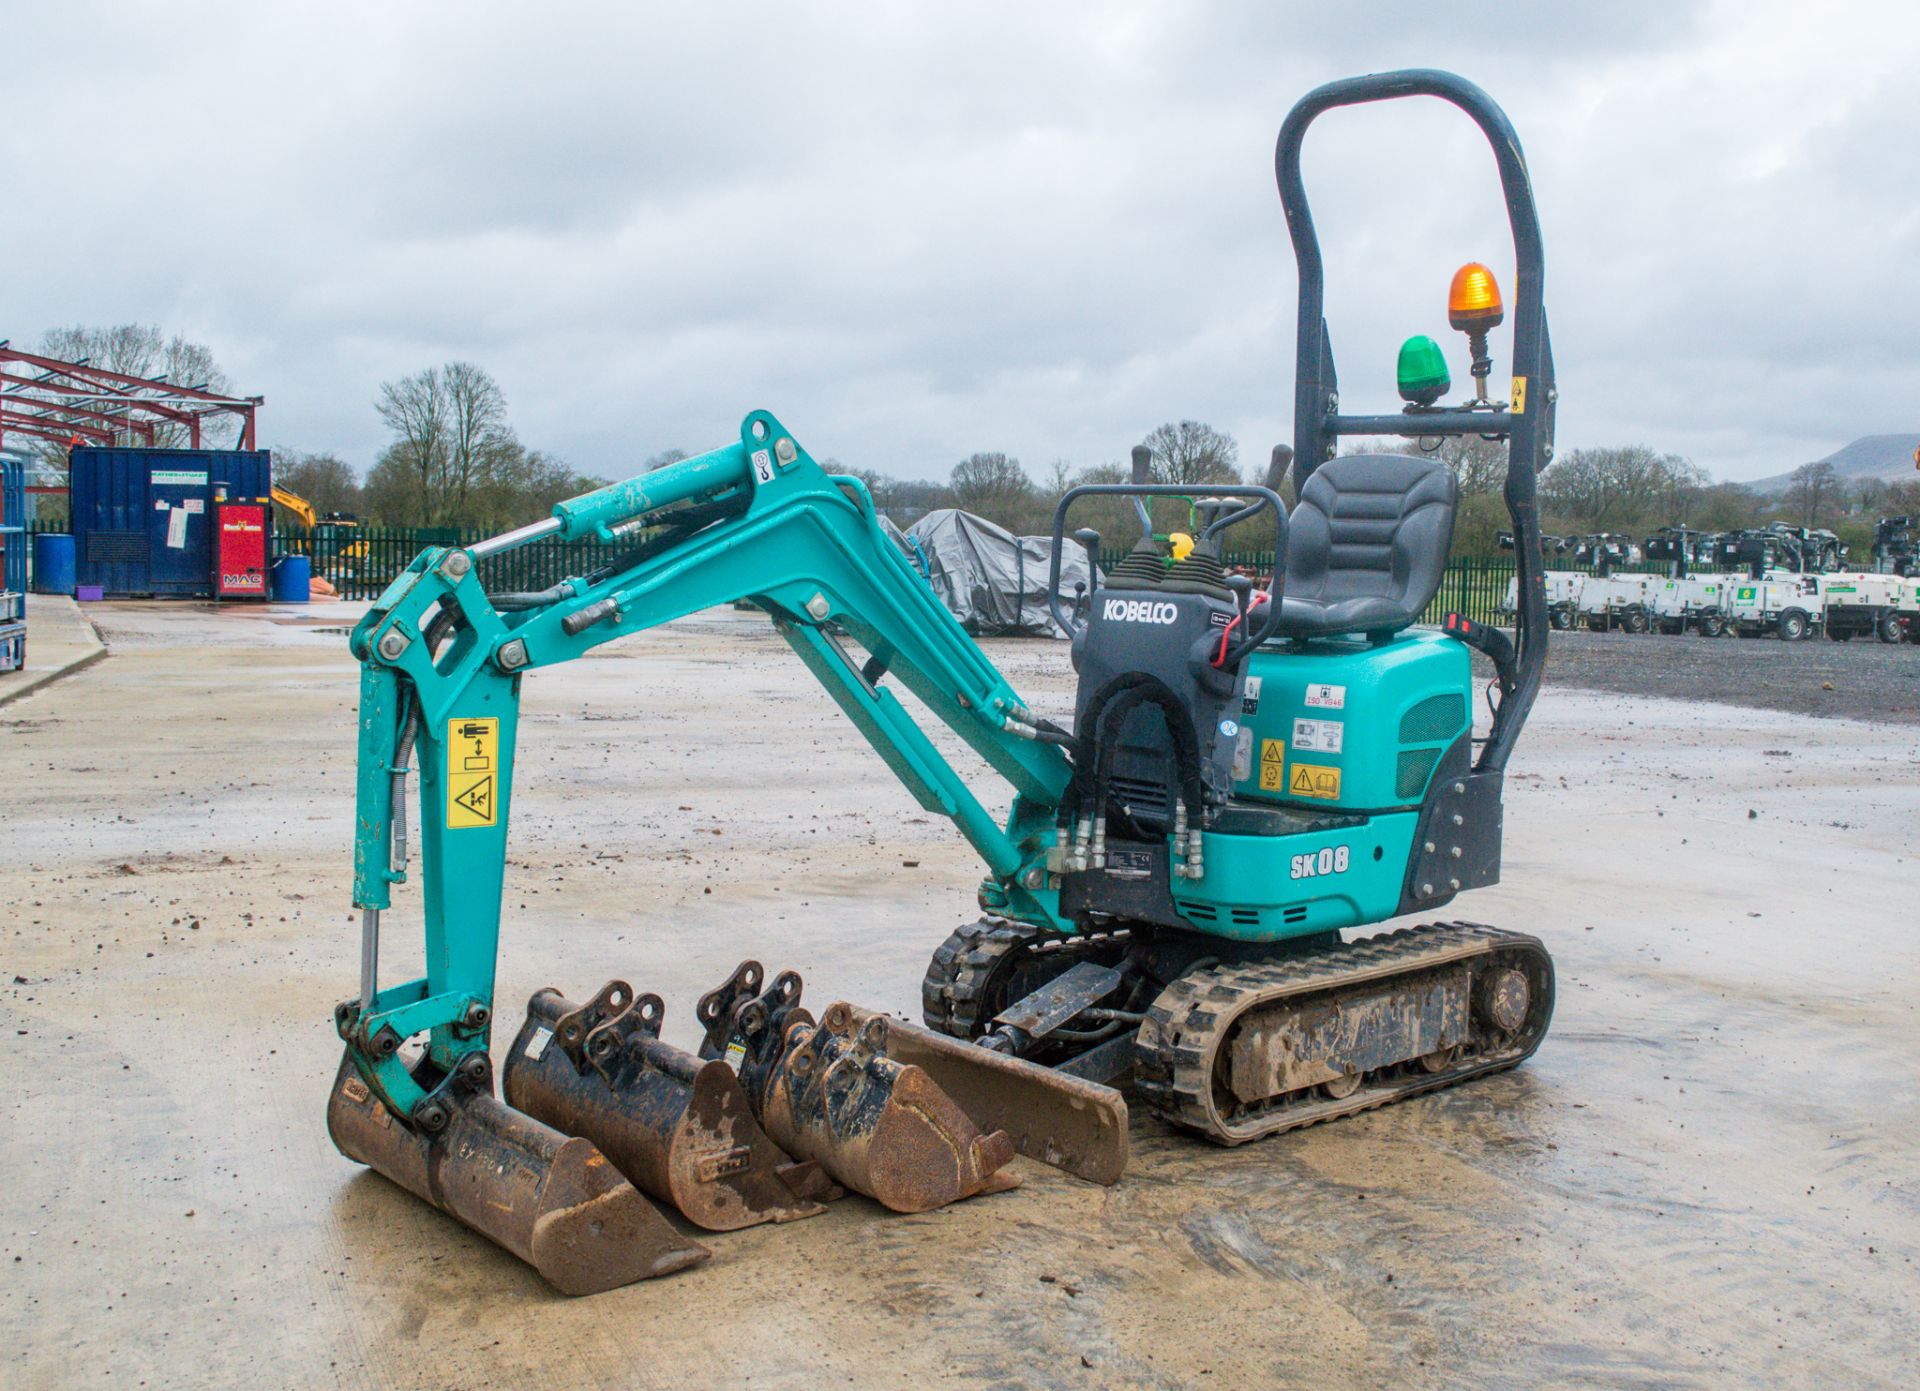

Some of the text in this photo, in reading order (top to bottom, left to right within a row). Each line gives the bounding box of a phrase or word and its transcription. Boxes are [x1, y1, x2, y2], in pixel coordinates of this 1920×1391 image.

[223, 574, 262, 584] MAC
[1102, 599, 1178, 625] KOBELCO
[1290, 843, 1350, 880] SK08
